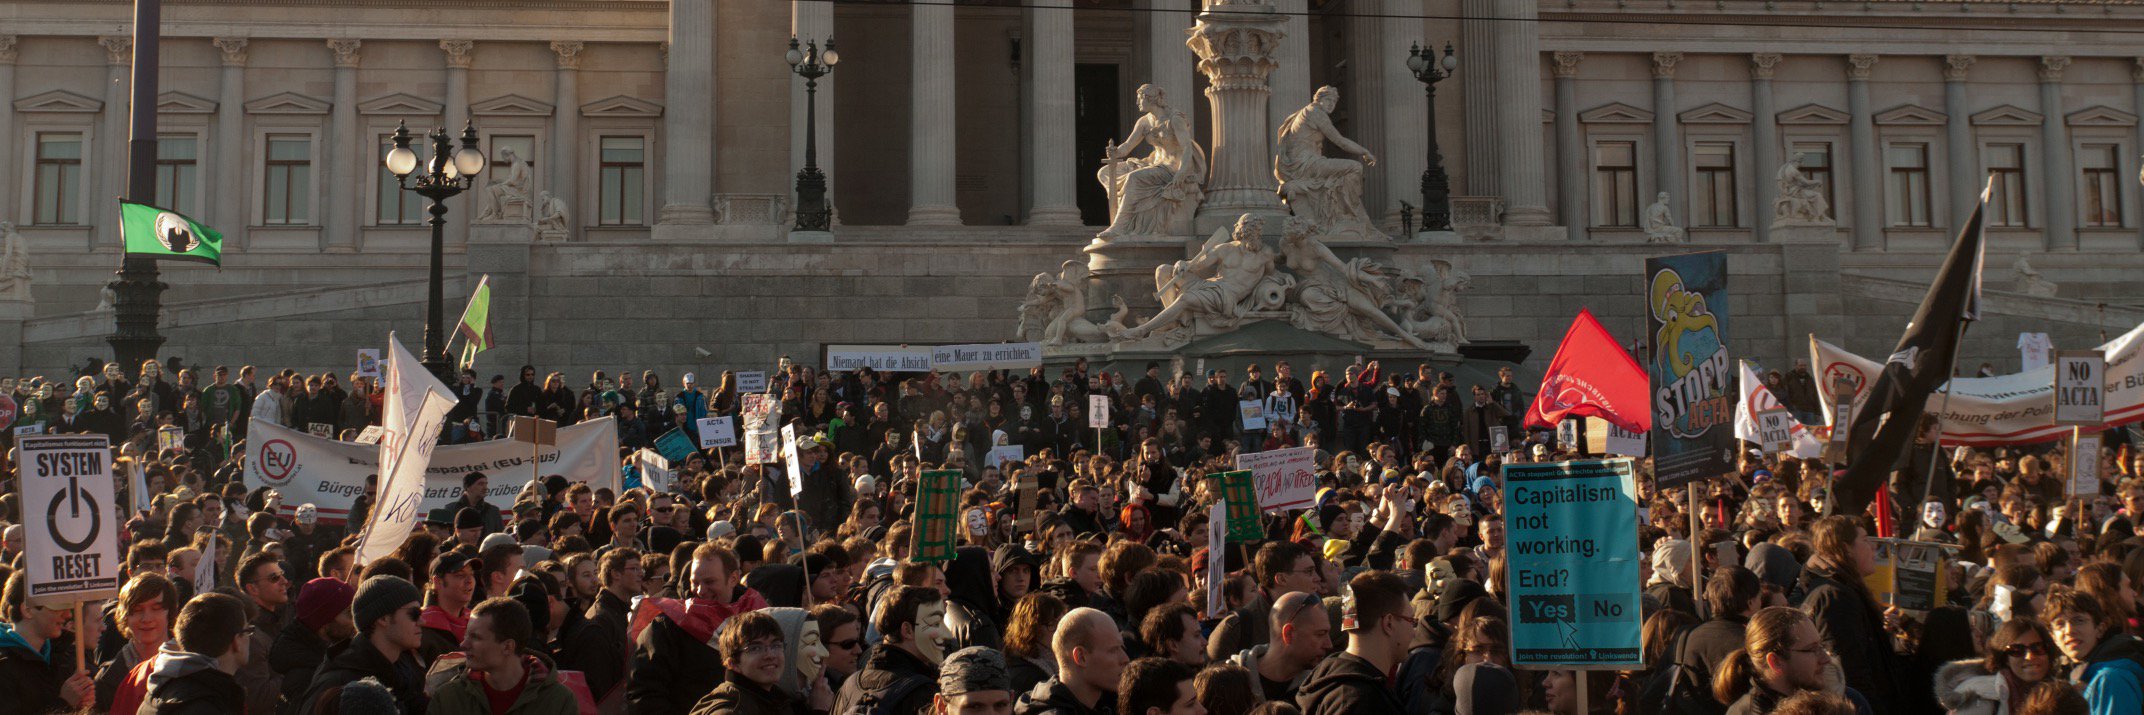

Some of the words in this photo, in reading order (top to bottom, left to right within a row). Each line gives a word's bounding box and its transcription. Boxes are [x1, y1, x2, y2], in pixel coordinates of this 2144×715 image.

[869, 356, 882, 368] hat
[885, 355, 898, 368] die
[934, 350, 951, 363] eine
[954, 349, 978, 362] Mauer
[982, 351, 992, 361] zu
[2068, 361, 2091, 381] NO
[1659, 348, 1729, 425] STOPP
[1994, 410, 2019, 421] der
[2125, 372, 2144, 390] Bü
[2059, 387, 2099, 406] ACTA
[1688, 396, 1730, 431] ACTA
[1765, 415, 1780, 428] NO
[310, 424, 330, 434] ACTA
[1763, 431, 1788, 443] ACTA
[705, 438, 732, 446] ZENSUR
[37, 452, 102, 477] SYSTEM
[268, 452, 291, 467] EU
[1509, 471, 1526, 479] ACTA
[1261, 468, 1282, 503] ACTA
[1514, 484, 1616, 508] Capitalism
[1516, 512, 1549, 530] not
[1516, 536, 1600, 557] working.
[52, 553, 102, 580] RESET
[1519, 569, 1569, 588] End?
[1528, 601, 1568, 617] Yes
[1594, 600, 1623, 617] No
[1535, 652, 1549, 660] the
[1550, 652, 1587, 660] revolution!
[1599, 652, 1638, 660] Linkswende
